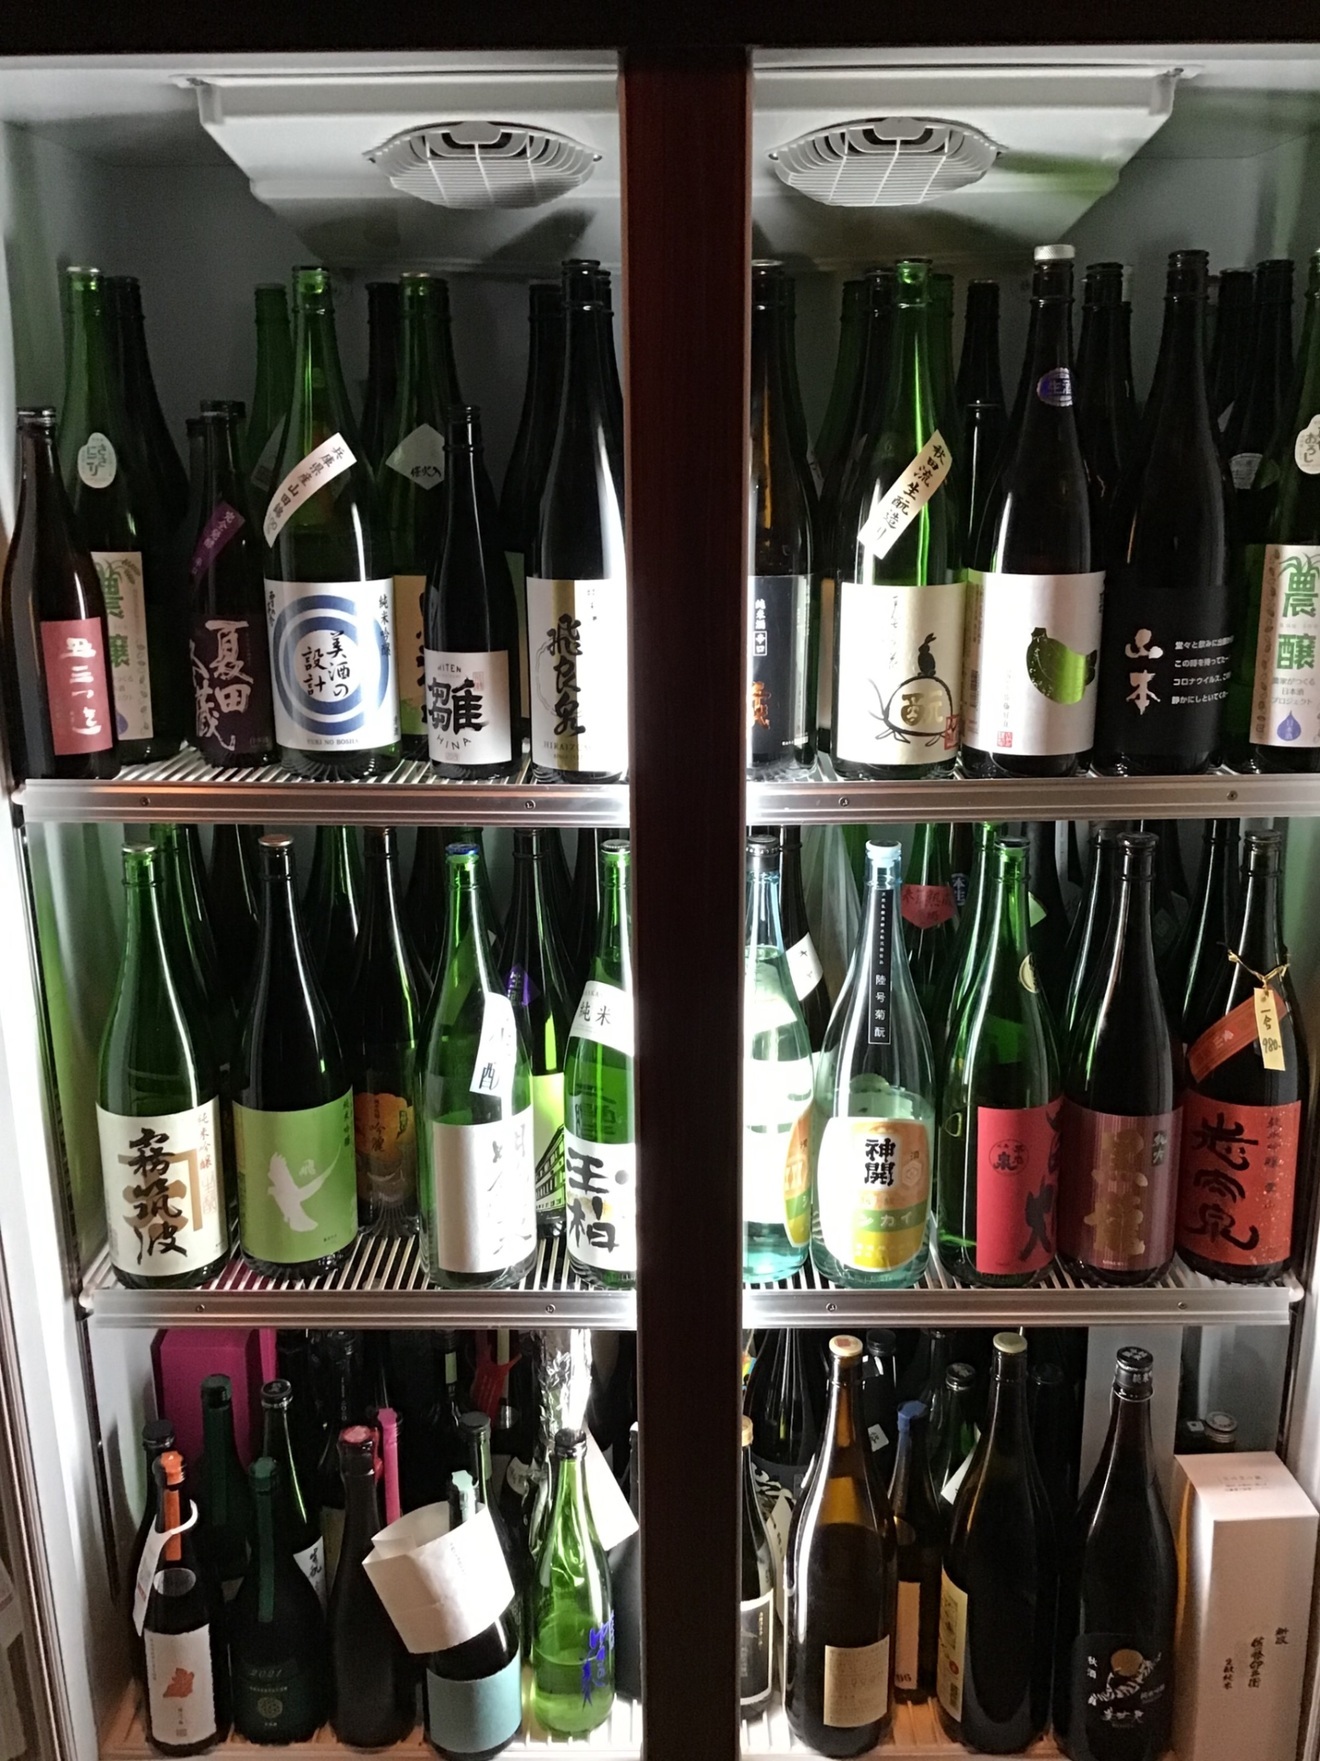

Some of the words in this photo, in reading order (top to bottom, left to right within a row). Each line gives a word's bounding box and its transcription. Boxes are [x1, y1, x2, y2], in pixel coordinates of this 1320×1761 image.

[272, 446, 346, 519] 兵庫県産山田錦
[877, 444, 947, 541] 秋田流生酛造り
[204, 619, 254, 714] 夏田
[301, 646, 328, 696] 設計
[326, 629, 351, 698] 美酒の
[755, 632, 766, 654] 辛口
[1124, 628, 1164, 716] 山本
[545, 612, 587, 738] 飛良泉
[1271, 697, 1312, 706] プロジェクト
[1281, 687, 1305, 696] 日本酒
[427, 676, 490, 736] 雛
[324, 738, 335, 746] NO
[436, 734, 473, 751] HINA
[578, 999, 612, 1027] 純米
[873, 974, 887, 1039] 陸号菊酛
[198, 1111, 213, 1171] 純米吟醸
[863, 1137, 897, 1187] 神開
[128, 1127, 188, 1266] 霧筑波
[248, 1666, 284, 1679] 2021
